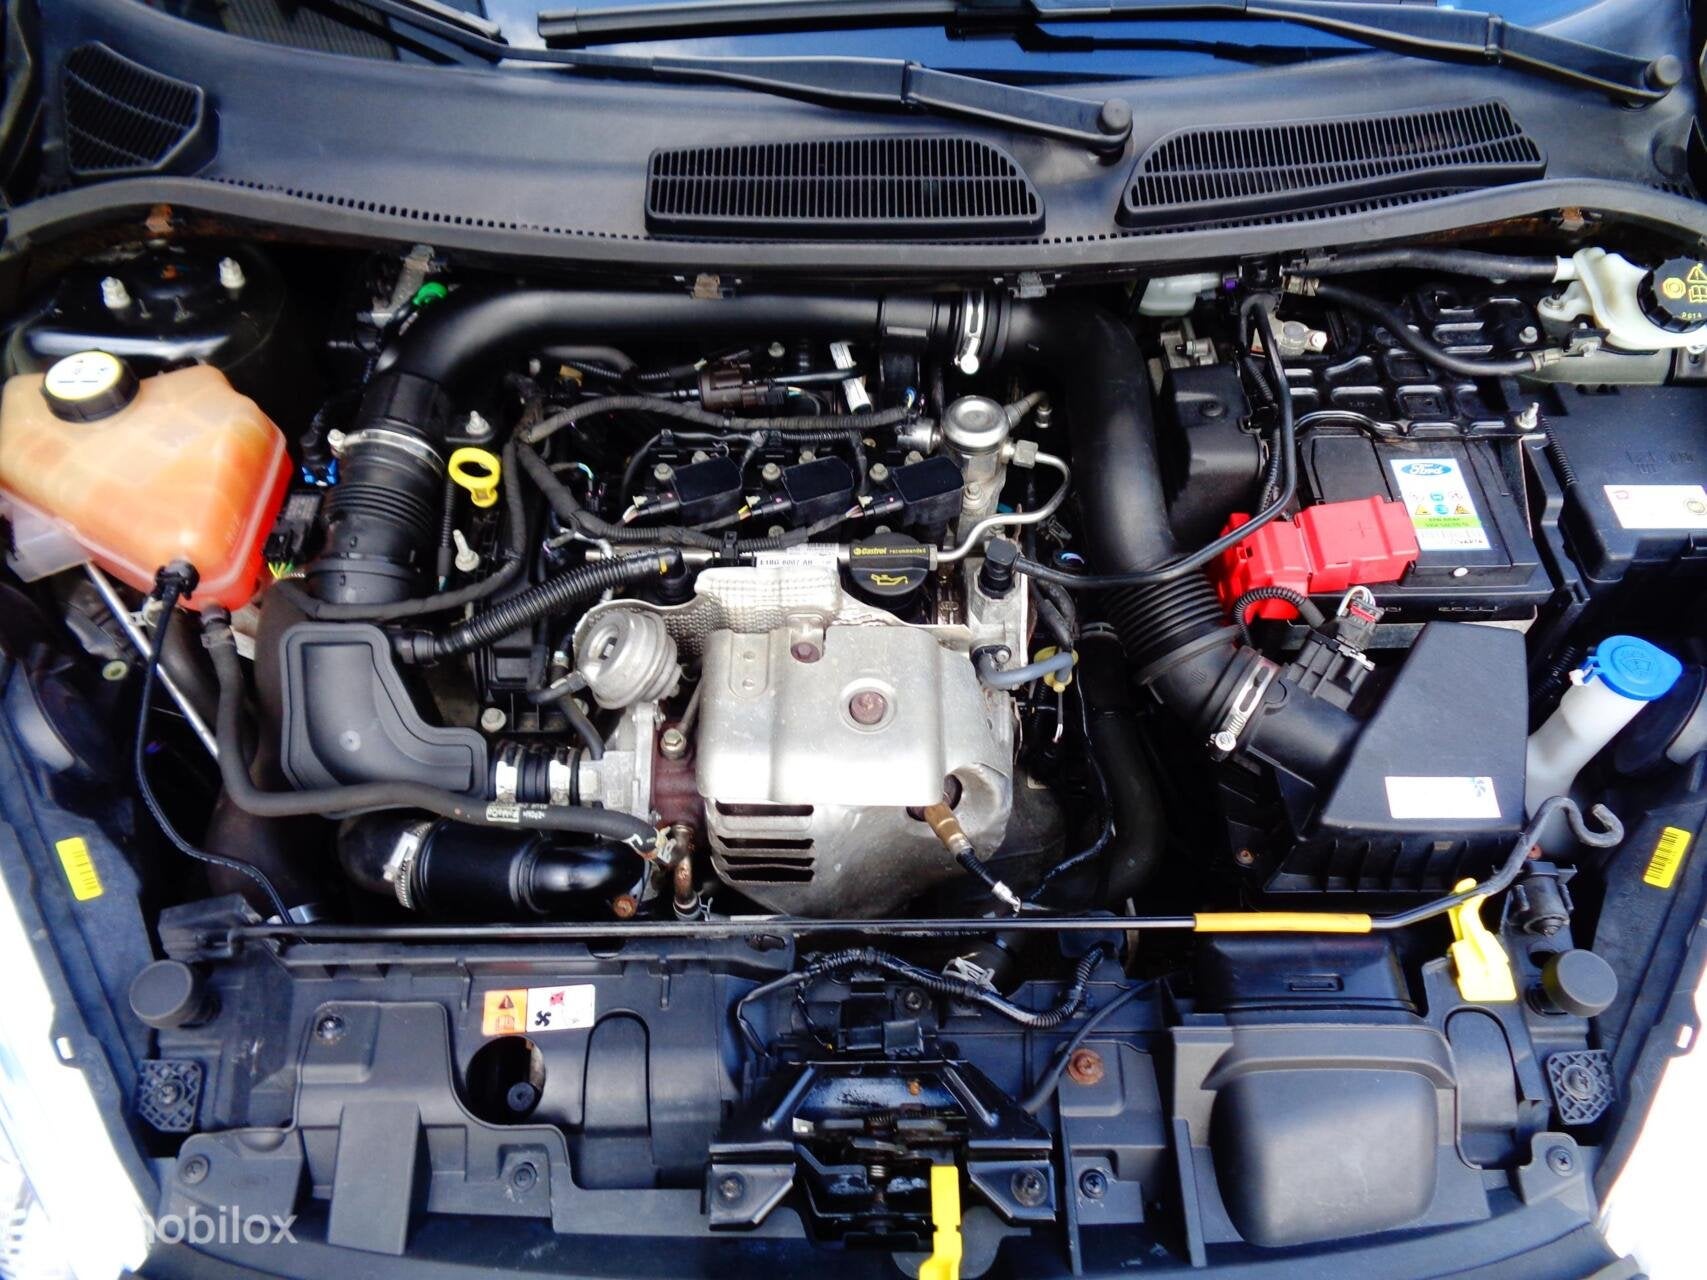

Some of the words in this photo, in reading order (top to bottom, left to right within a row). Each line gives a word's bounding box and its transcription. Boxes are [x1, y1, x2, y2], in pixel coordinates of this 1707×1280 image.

[1408, 463, 1443, 475] Ford
[862, 547, 887, 556] Castrol
[889, 547, 927, 555] recommended
